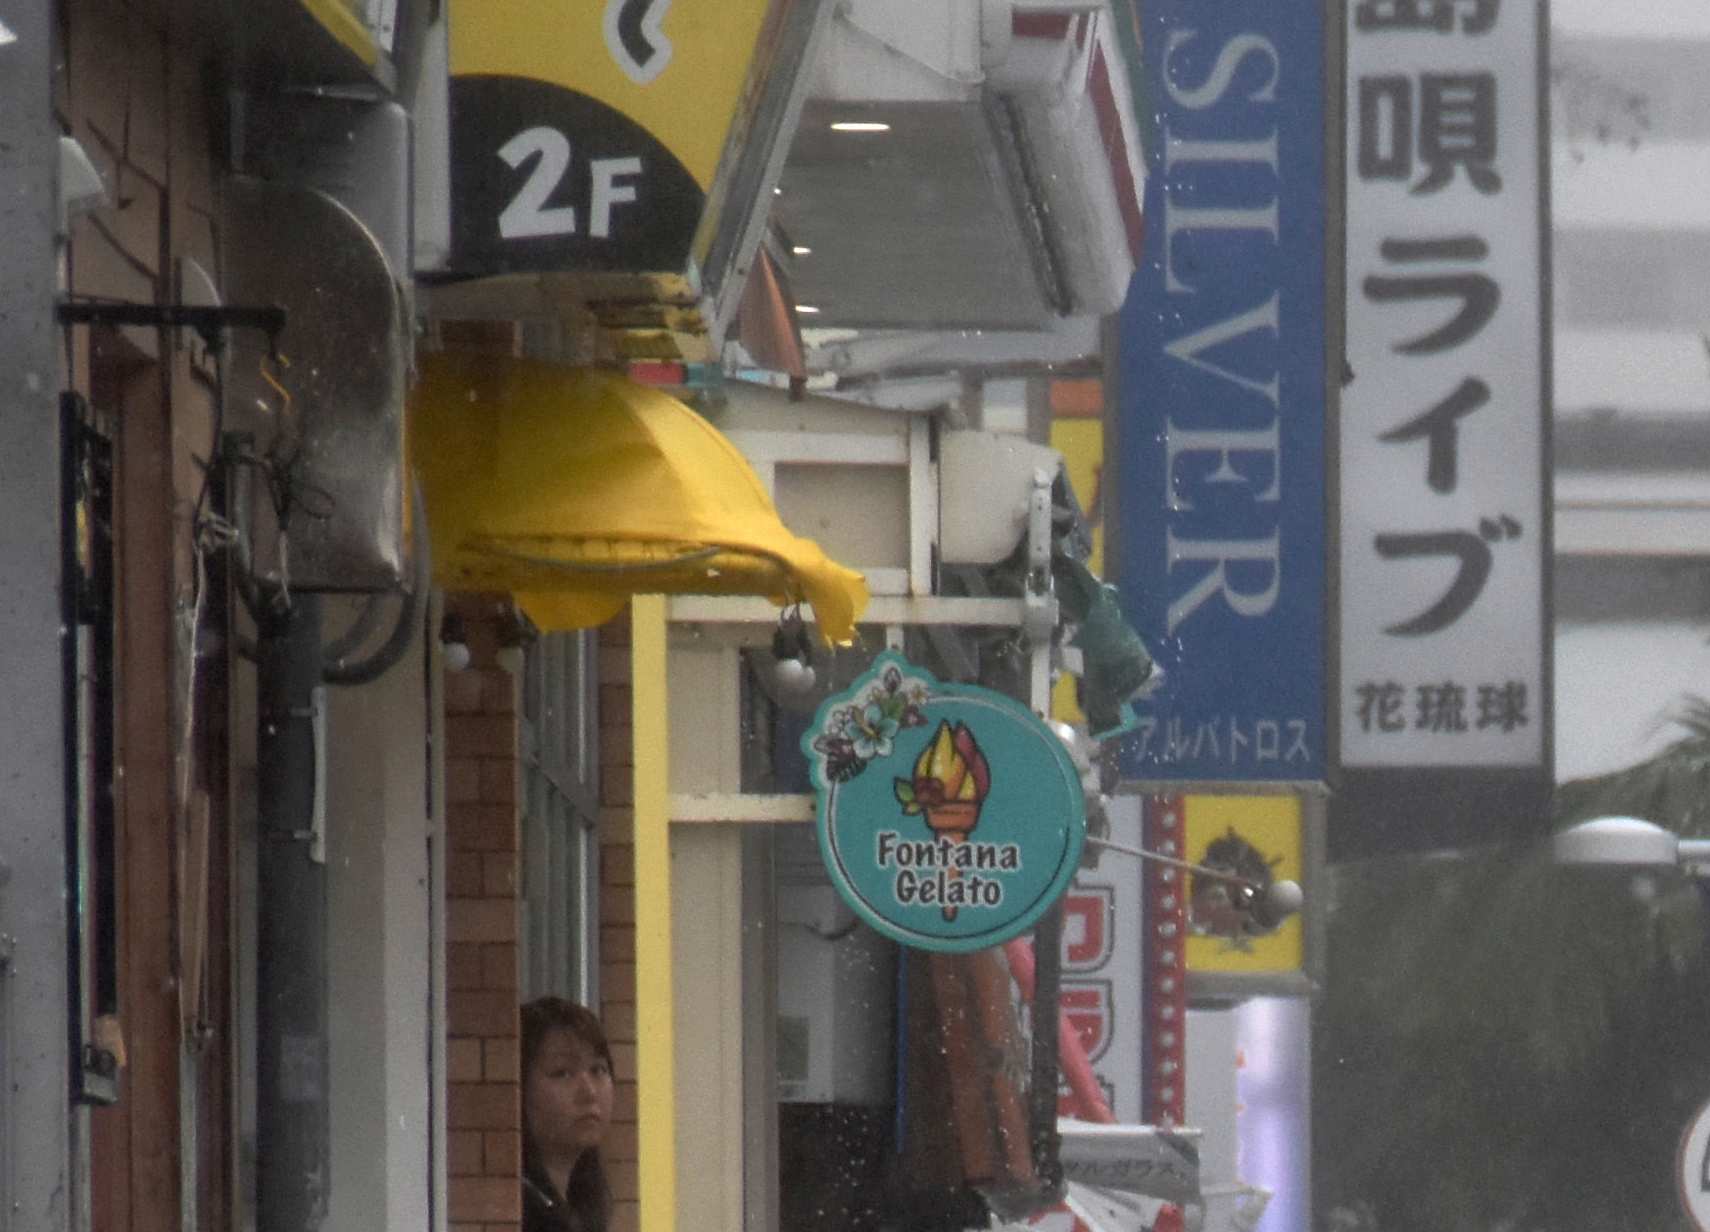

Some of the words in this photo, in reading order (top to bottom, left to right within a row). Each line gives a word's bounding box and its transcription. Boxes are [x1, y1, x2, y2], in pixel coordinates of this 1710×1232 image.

[496, 126, 643, 240] 2F
[1162, 27, 1281, 638] SILVER
[1355, 683, 1530, 735] 花琉球
[876, 832, 1019, 870] Fontana
[895, 867, 1003, 908] Gelato
